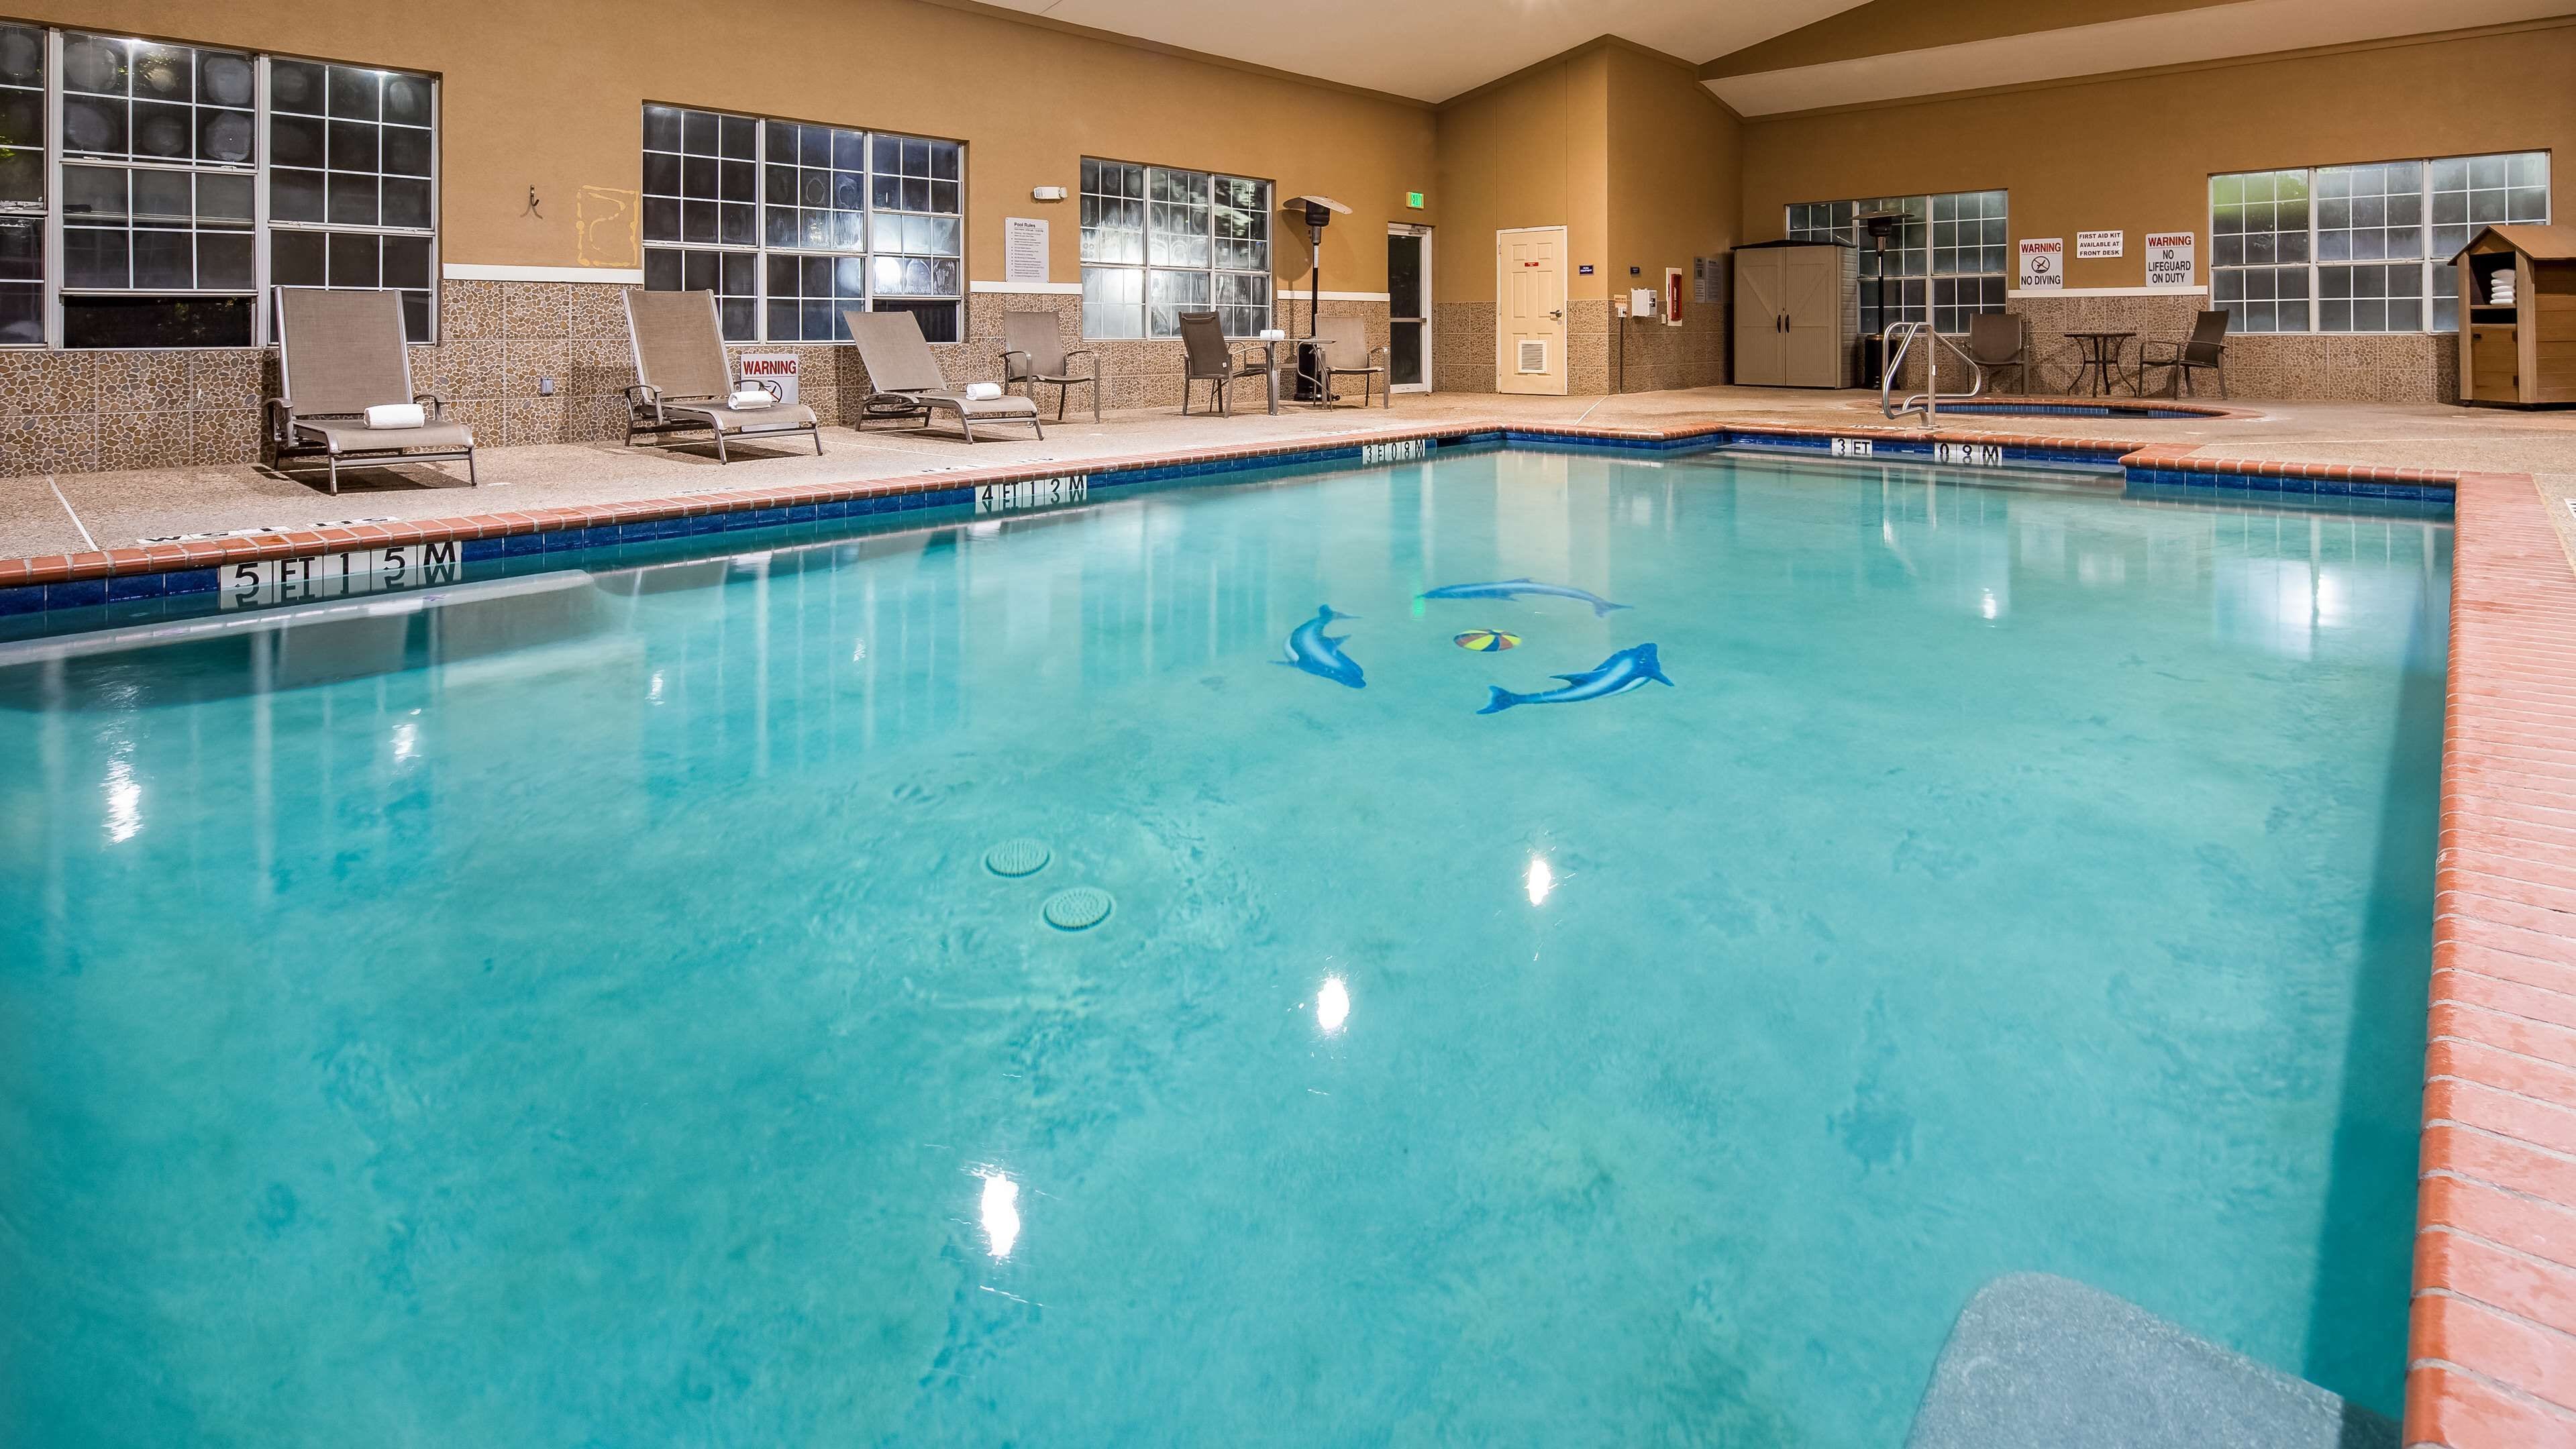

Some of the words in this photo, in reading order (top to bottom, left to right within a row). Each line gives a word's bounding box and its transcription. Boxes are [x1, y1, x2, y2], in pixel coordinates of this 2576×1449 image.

[2148, 236, 2192, 247] WARNING
[2021, 243, 2061, 253] WARNING
[2163, 250, 2174, 260] NO
[2149, 261, 2192, 272] LIFEGUARD
[2021, 276, 2032, 285] NO
[2034, 275, 2061, 285] DIVING
[2152, 273, 2163, 283] ON
[2165, 272, 2185, 283] DUTY
[743, 360, 796, 374] WARNING
[1983, 445, 1998, 457] M
[982, 485, 993, 500] 4
[1069, 475, 1084, 490] M
[235, 562, 260, 588] 5
[281, 557, 315, 583] FT
[423, 541, 456, 566] M
